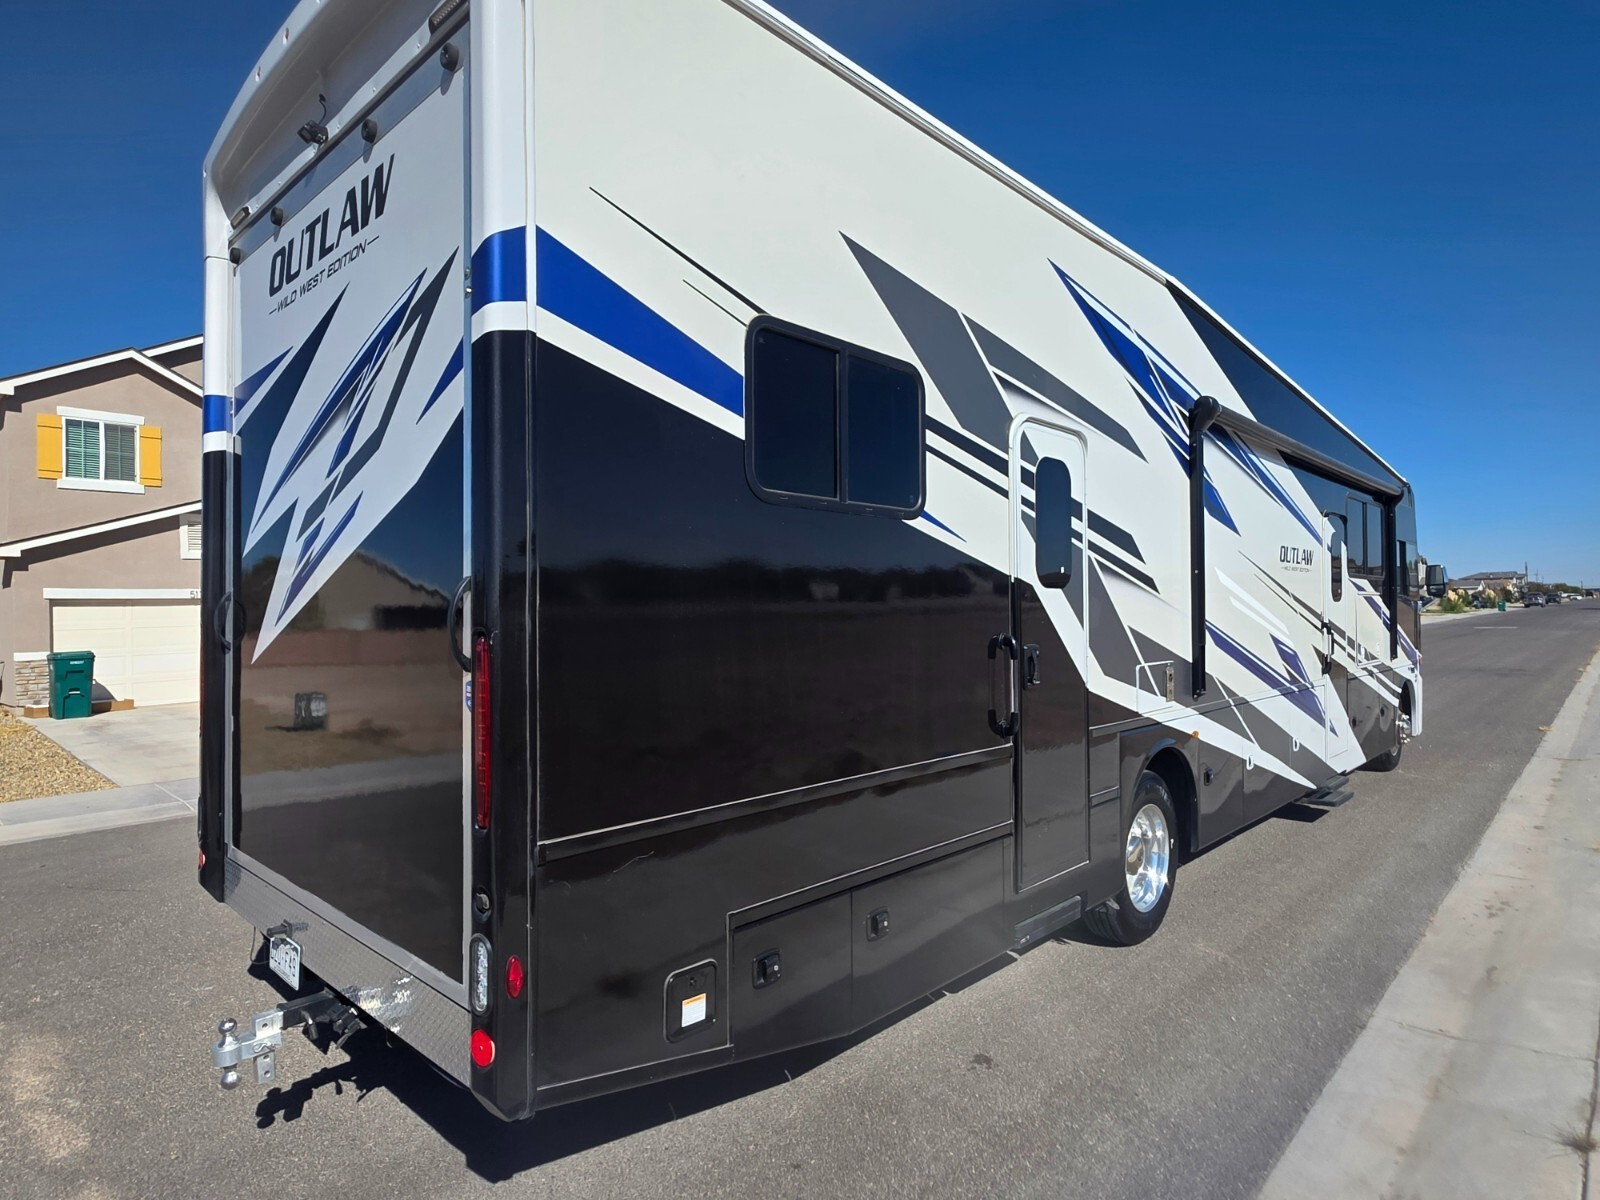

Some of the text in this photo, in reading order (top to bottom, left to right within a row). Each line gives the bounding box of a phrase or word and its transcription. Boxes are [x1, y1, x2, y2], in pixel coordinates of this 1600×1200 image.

[269, 153, 395, 297] OUTLAW
[277, 239, 367, 313] WILD WEST EDITION
[1280, 545, 1314, 566] OUTLAW
